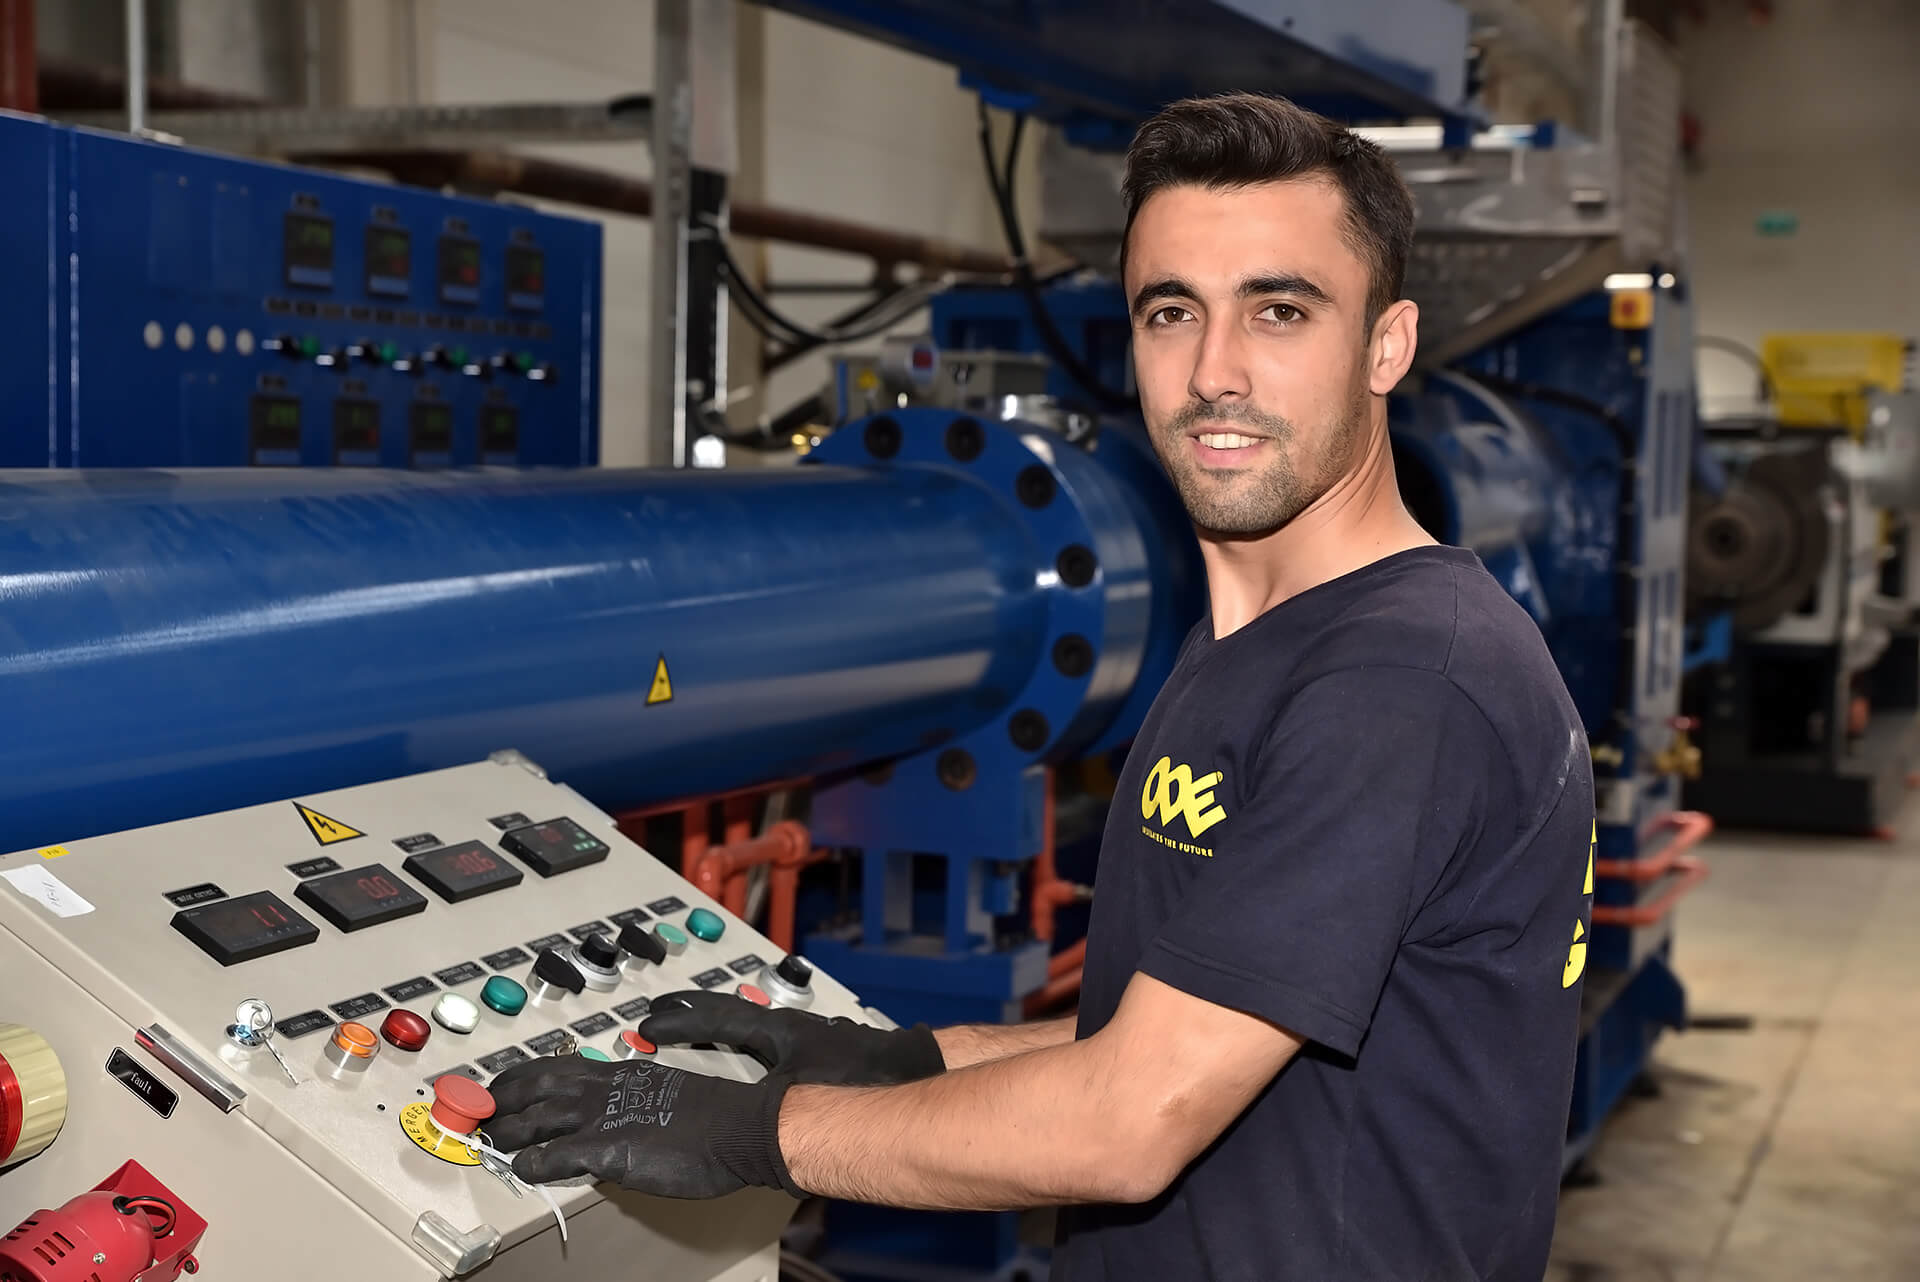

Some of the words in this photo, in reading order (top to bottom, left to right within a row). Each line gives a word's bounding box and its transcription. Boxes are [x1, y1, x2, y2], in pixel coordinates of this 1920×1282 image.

[1164, 837, 1176, 849] THE
[1178, 842, 1214, 857] FUTURE
[130, 1072, 153, 1095] fault
[606, 1091, 622, 1116] PU
